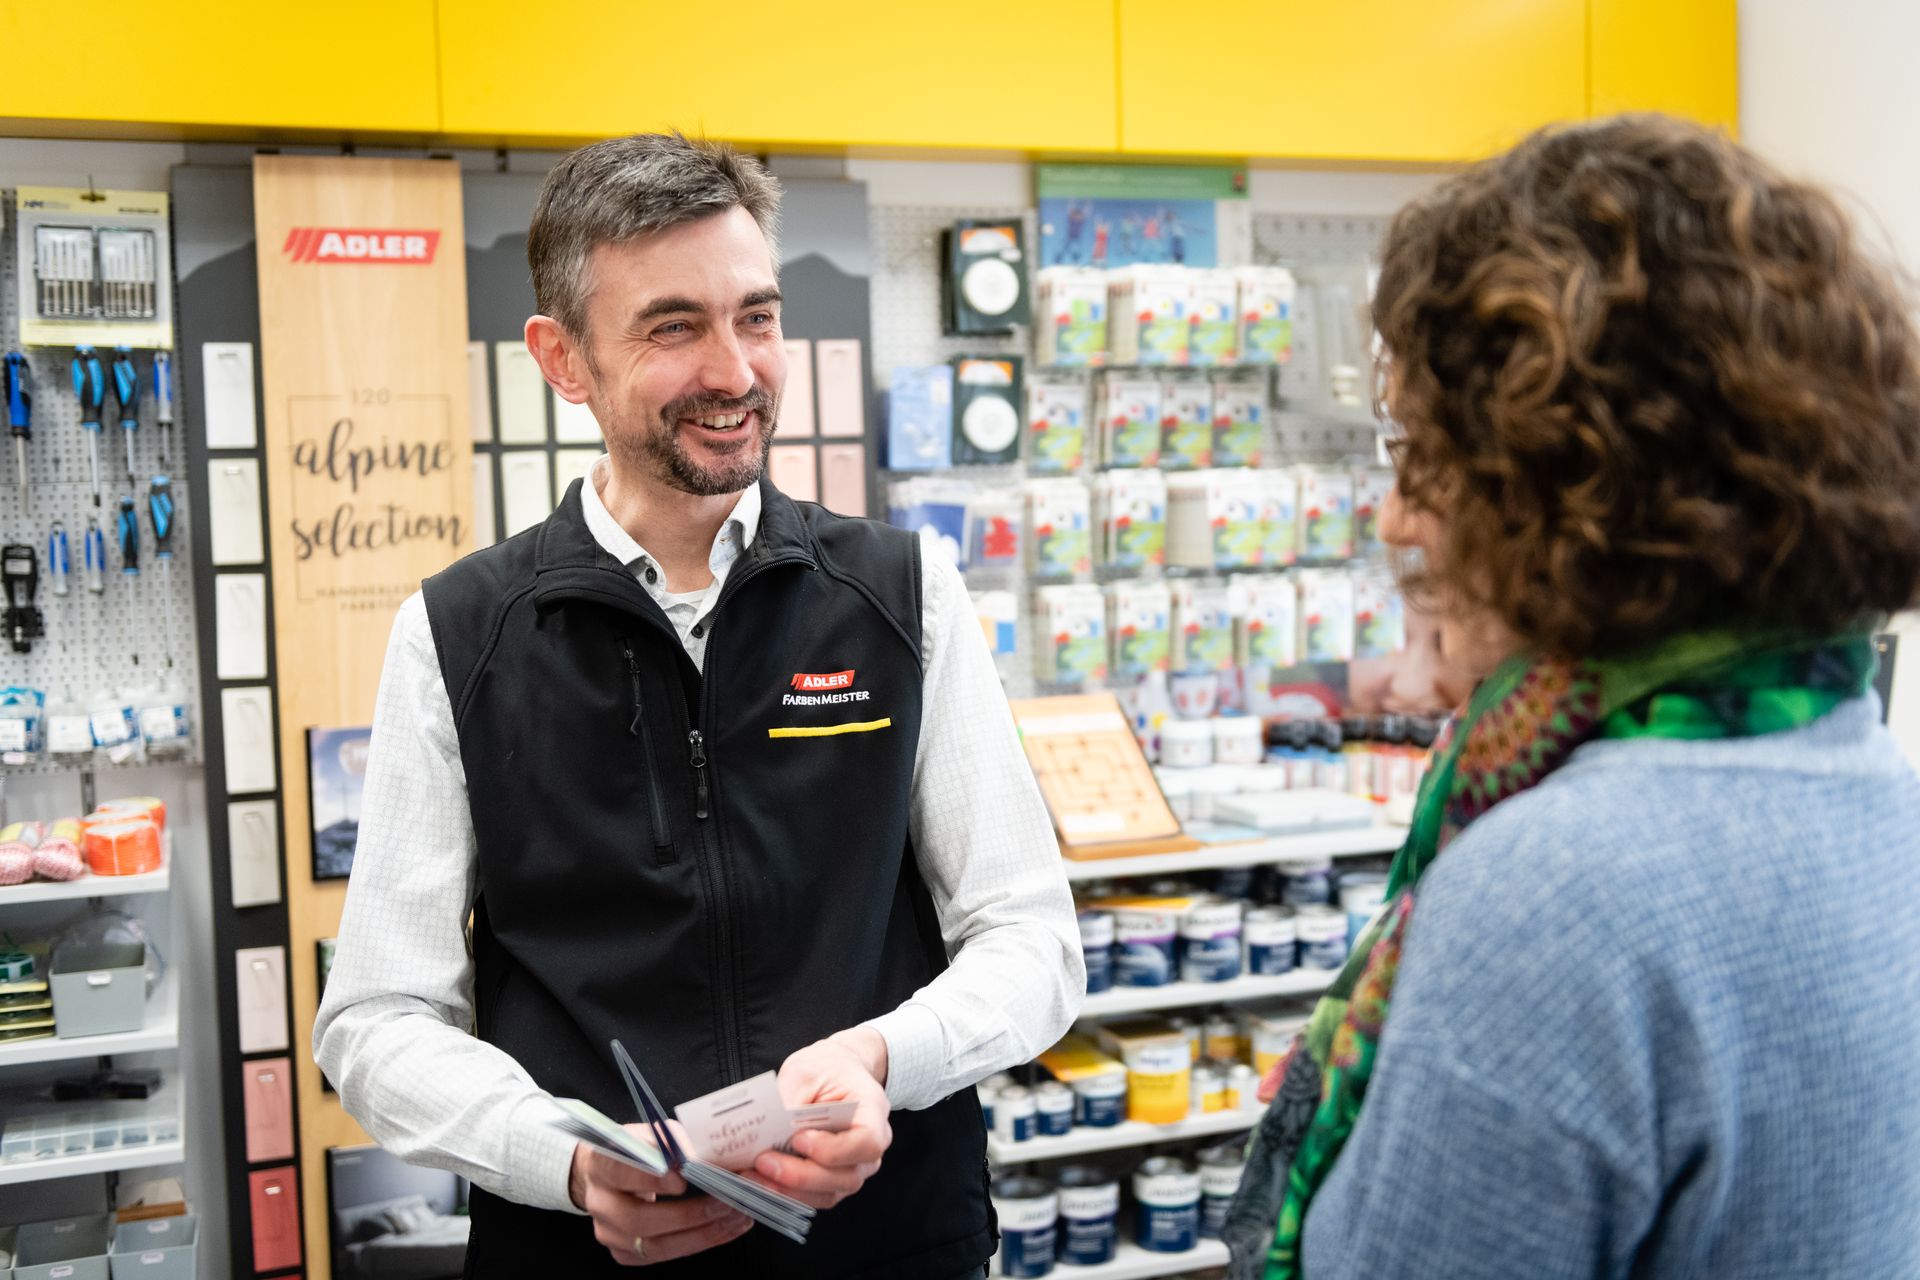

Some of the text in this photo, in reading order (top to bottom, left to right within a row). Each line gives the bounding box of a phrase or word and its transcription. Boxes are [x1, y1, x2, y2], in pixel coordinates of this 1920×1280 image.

[318, 232, 427, 259] ADLER
[352, 388, 391, 405] 120
[292, 417, 455, 493] alpine
[291, 502, 467, 561] selection
[802, 674, 849, 688] ADLER
[782, 691, 870, 706] FARBENMEISTER
